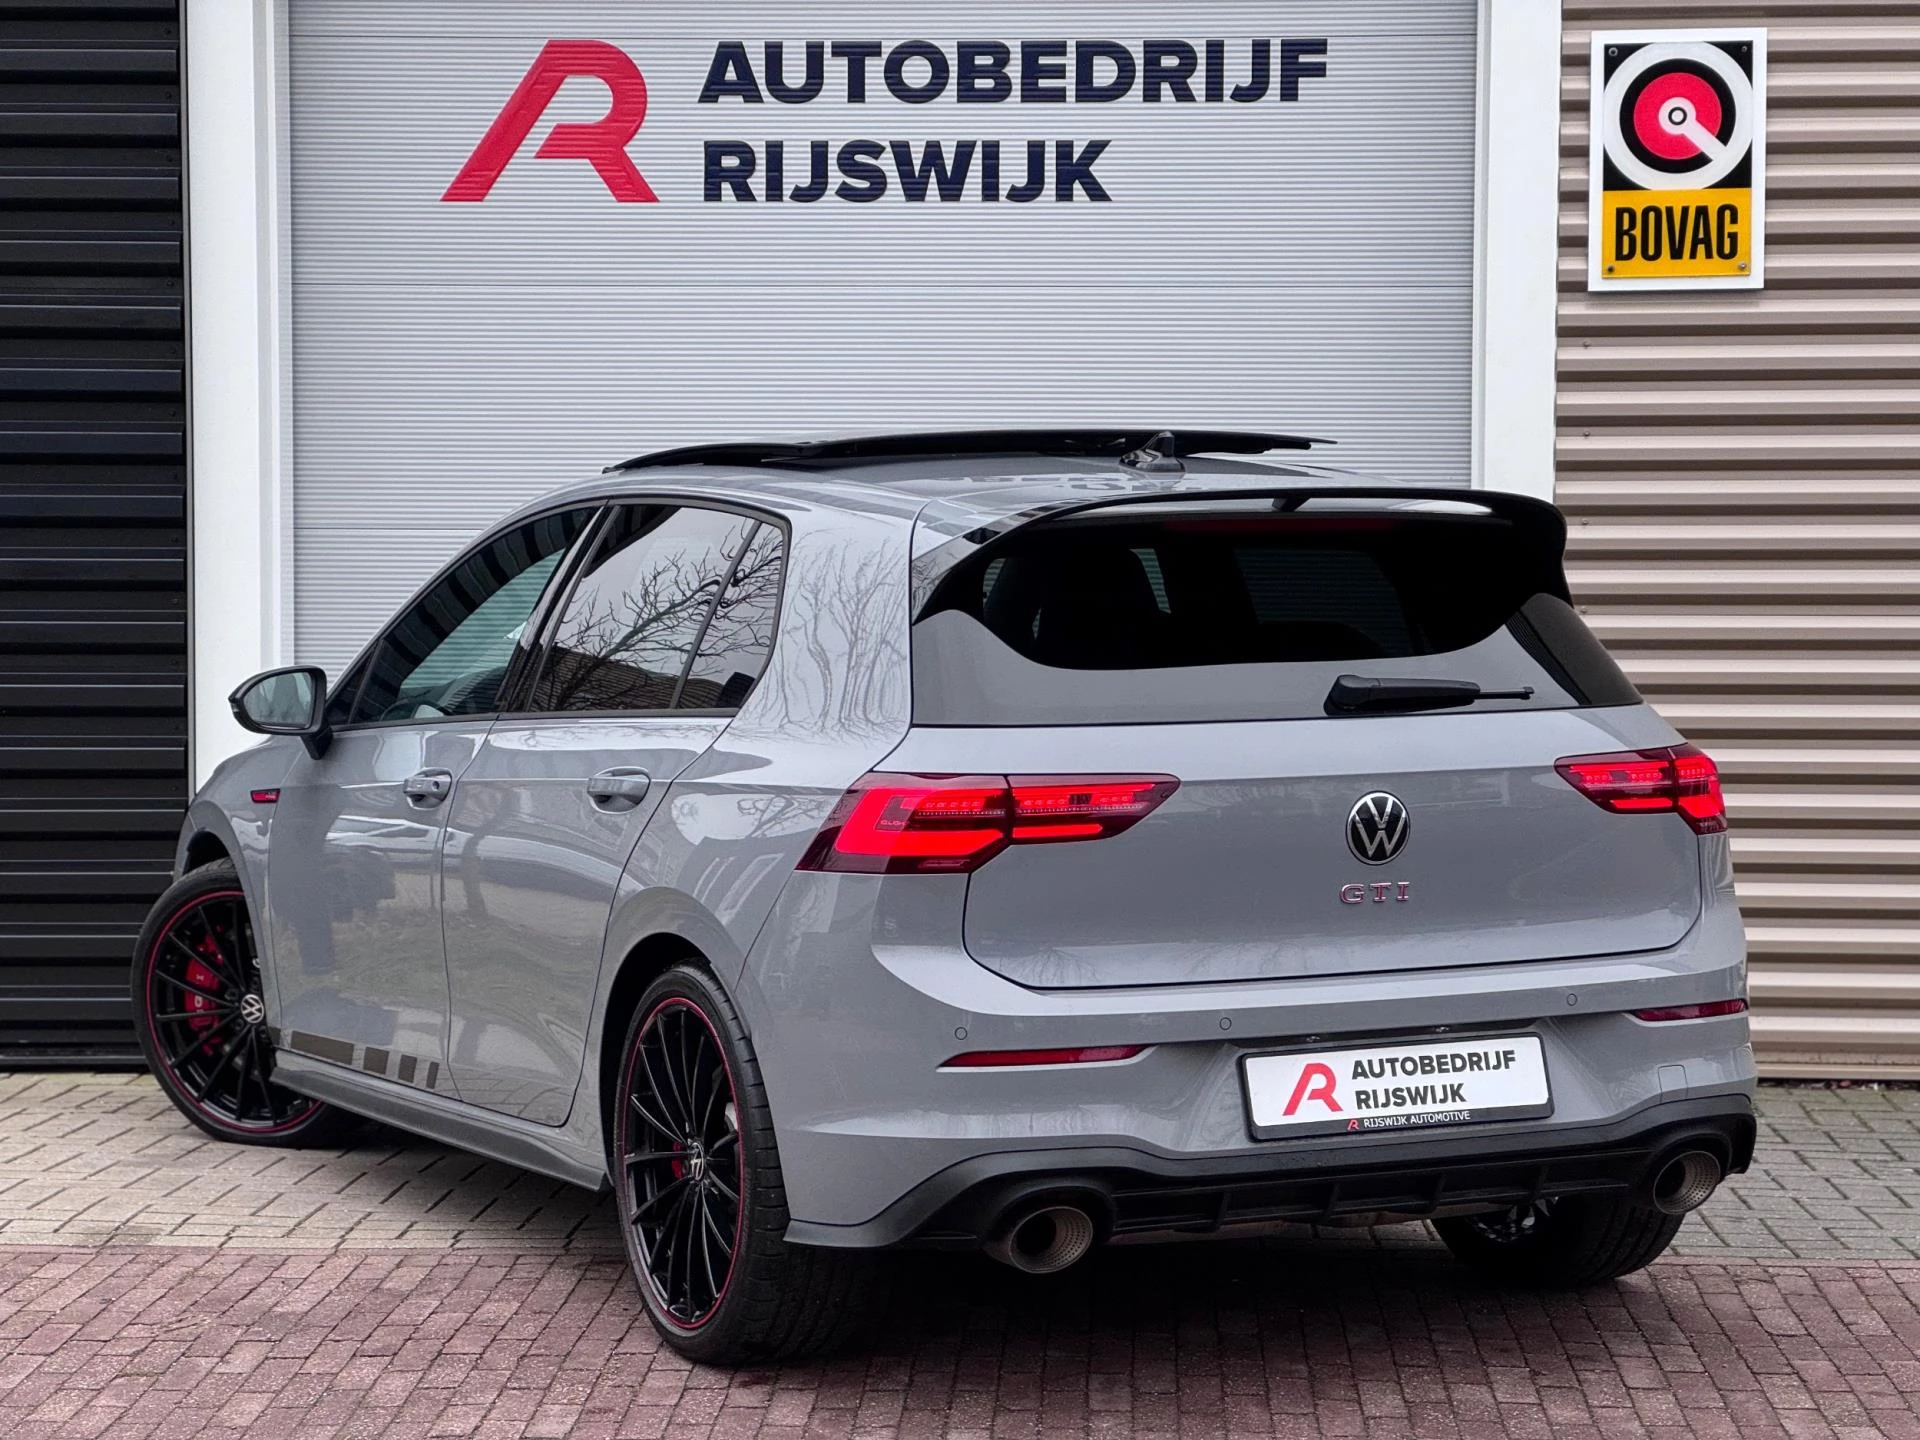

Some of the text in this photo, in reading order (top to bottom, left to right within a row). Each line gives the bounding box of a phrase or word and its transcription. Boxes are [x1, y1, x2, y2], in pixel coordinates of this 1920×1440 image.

[698, 38, 1328, 104] AUTOBEDRIJF
[703, 139, 1113, 203] RIJSWIJK
[1615, 204, 1739, 262] BOVAG
[1340, 881, 1411, 904] GTI
[1351, 1049, 1517, 1080] AUTOBEDRIJF
[1355, 1083, 1467, 1110] RIJSWIJK
[1363, 1117, 1407, 1128] RIJSWIJK
[1410, 1110, 1471, 1124] AUTOMOTIVE
